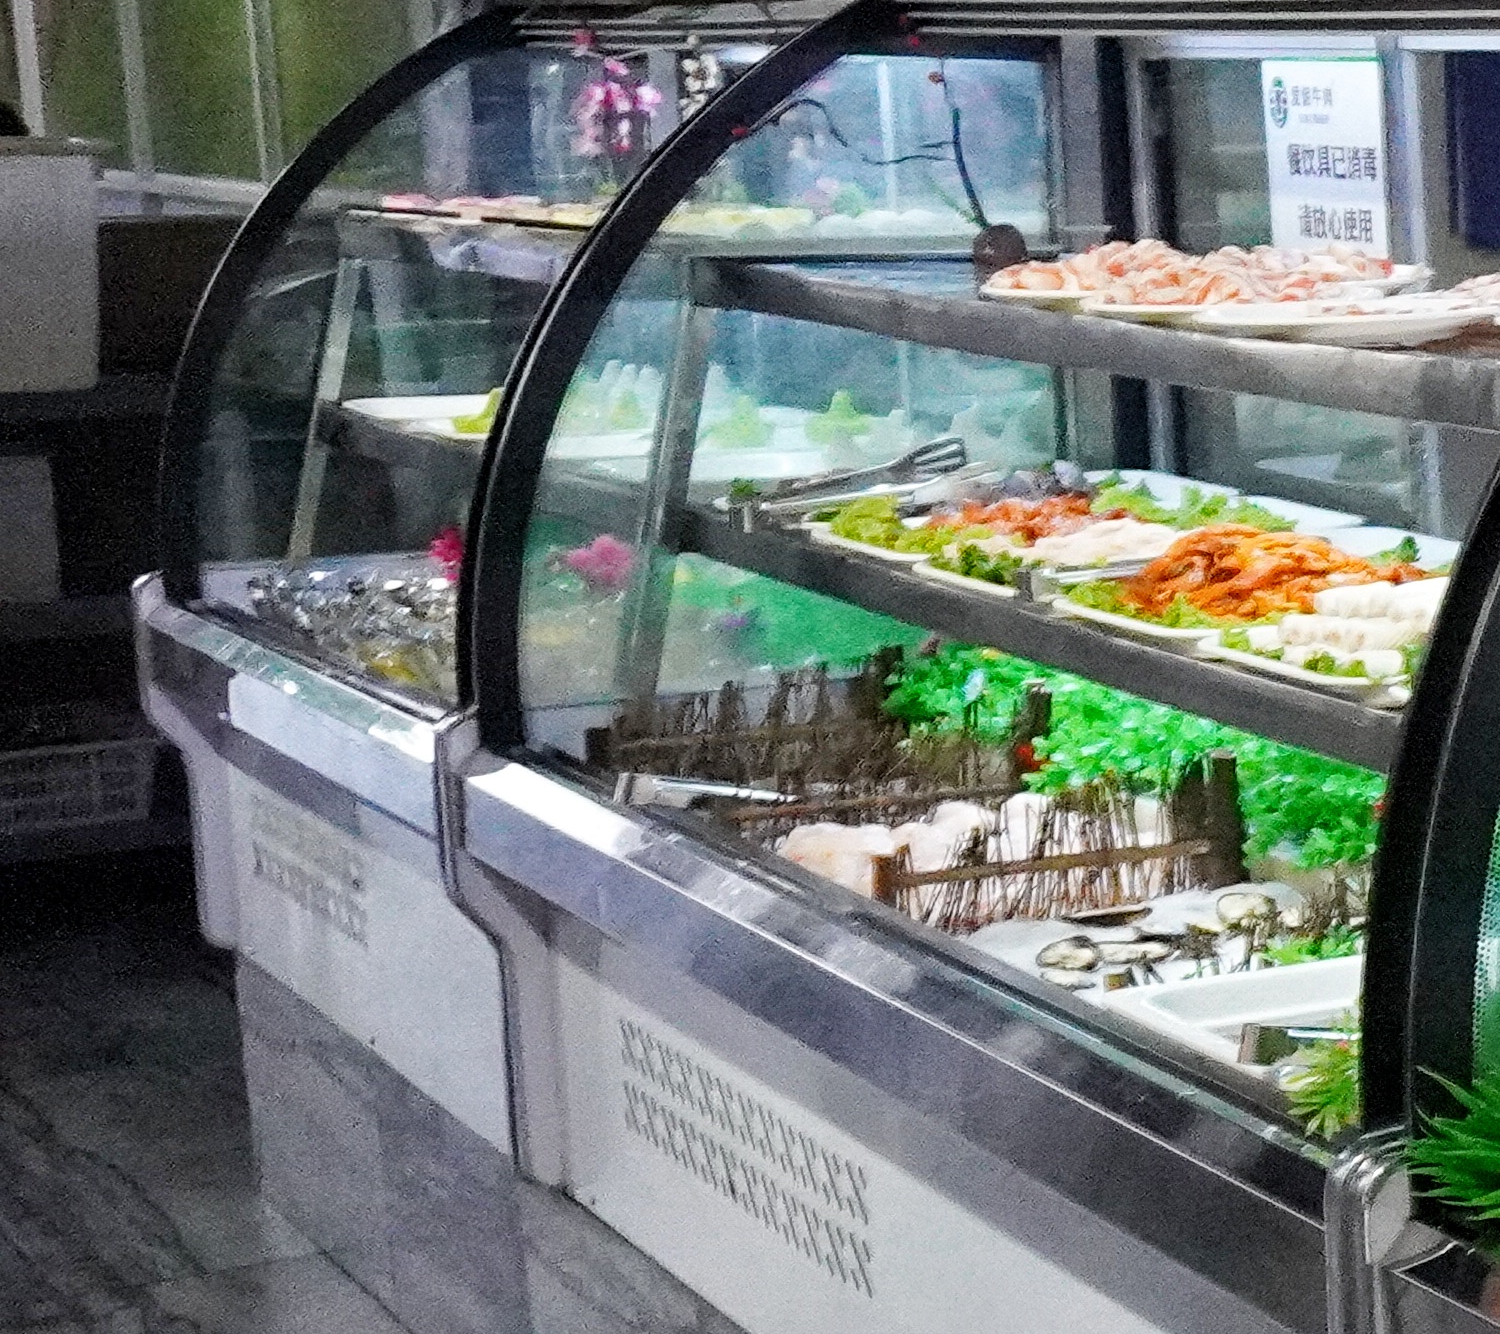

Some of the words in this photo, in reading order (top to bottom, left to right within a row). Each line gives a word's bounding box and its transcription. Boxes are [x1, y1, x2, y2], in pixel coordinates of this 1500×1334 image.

[1287, 143, 1377, 181] 餐饮具已消毒
[1298, 204, 1373, 244] 请放心使用
